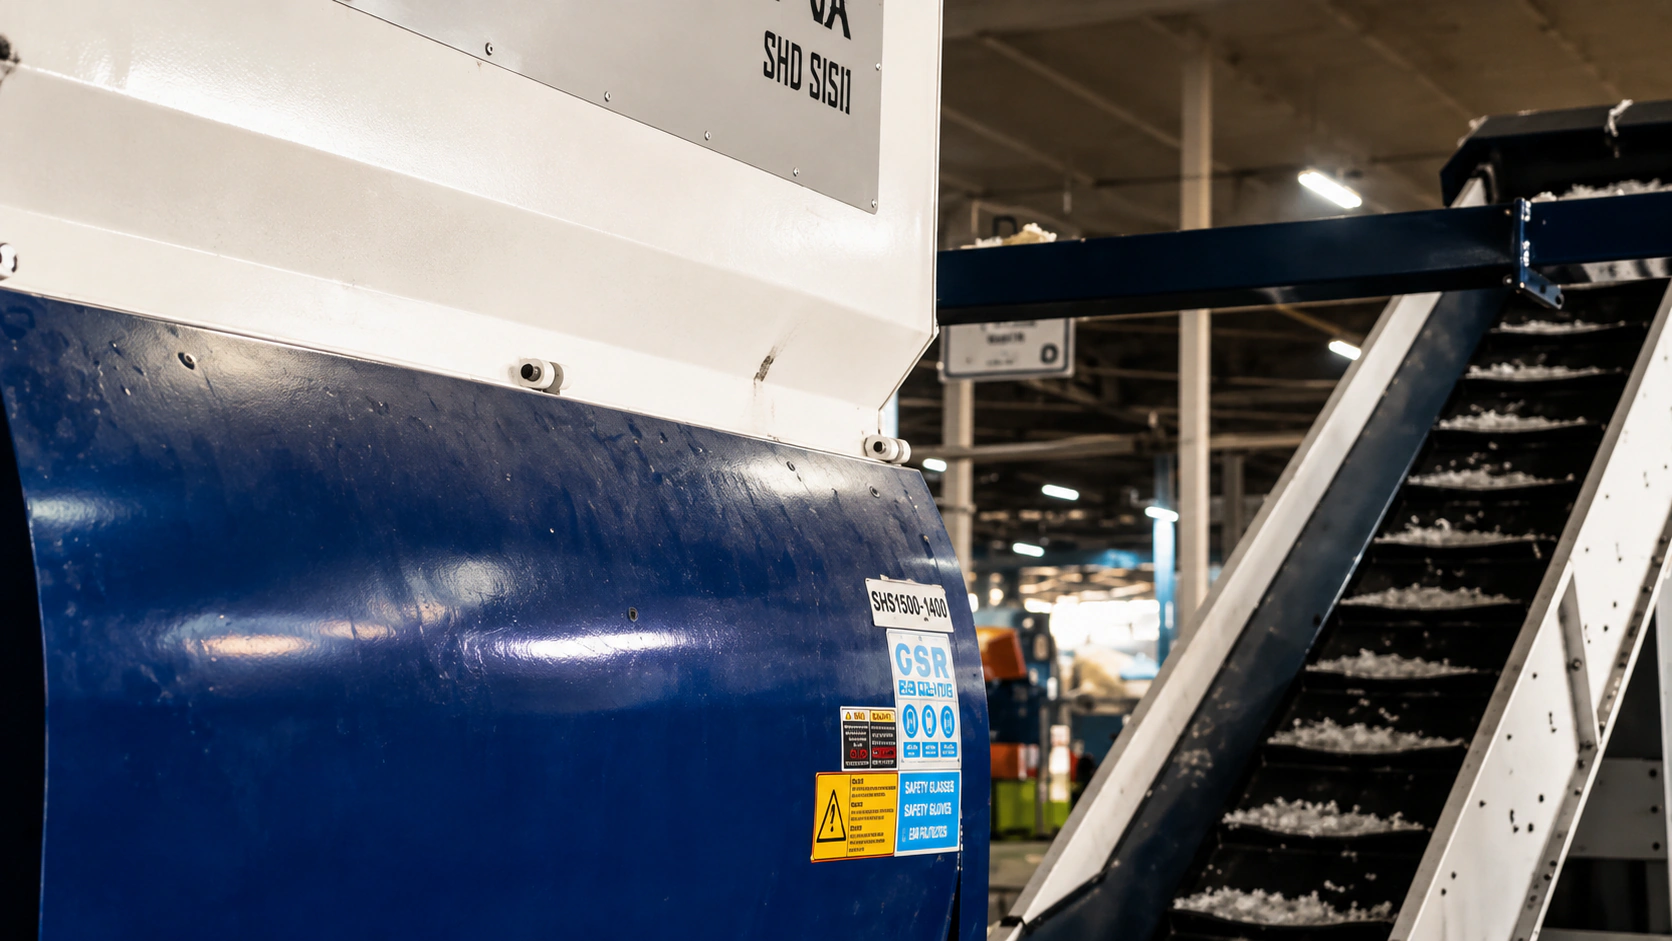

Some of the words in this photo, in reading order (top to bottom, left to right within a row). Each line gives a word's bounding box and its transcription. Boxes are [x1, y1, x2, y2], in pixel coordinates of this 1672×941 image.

[763, 30, 802, 91] SHD
[871, 590, 948, 618] SHS1500-1400
[905, 781, 928, 794] SAFETY
[904, 803, 928, 817] SAFETY
